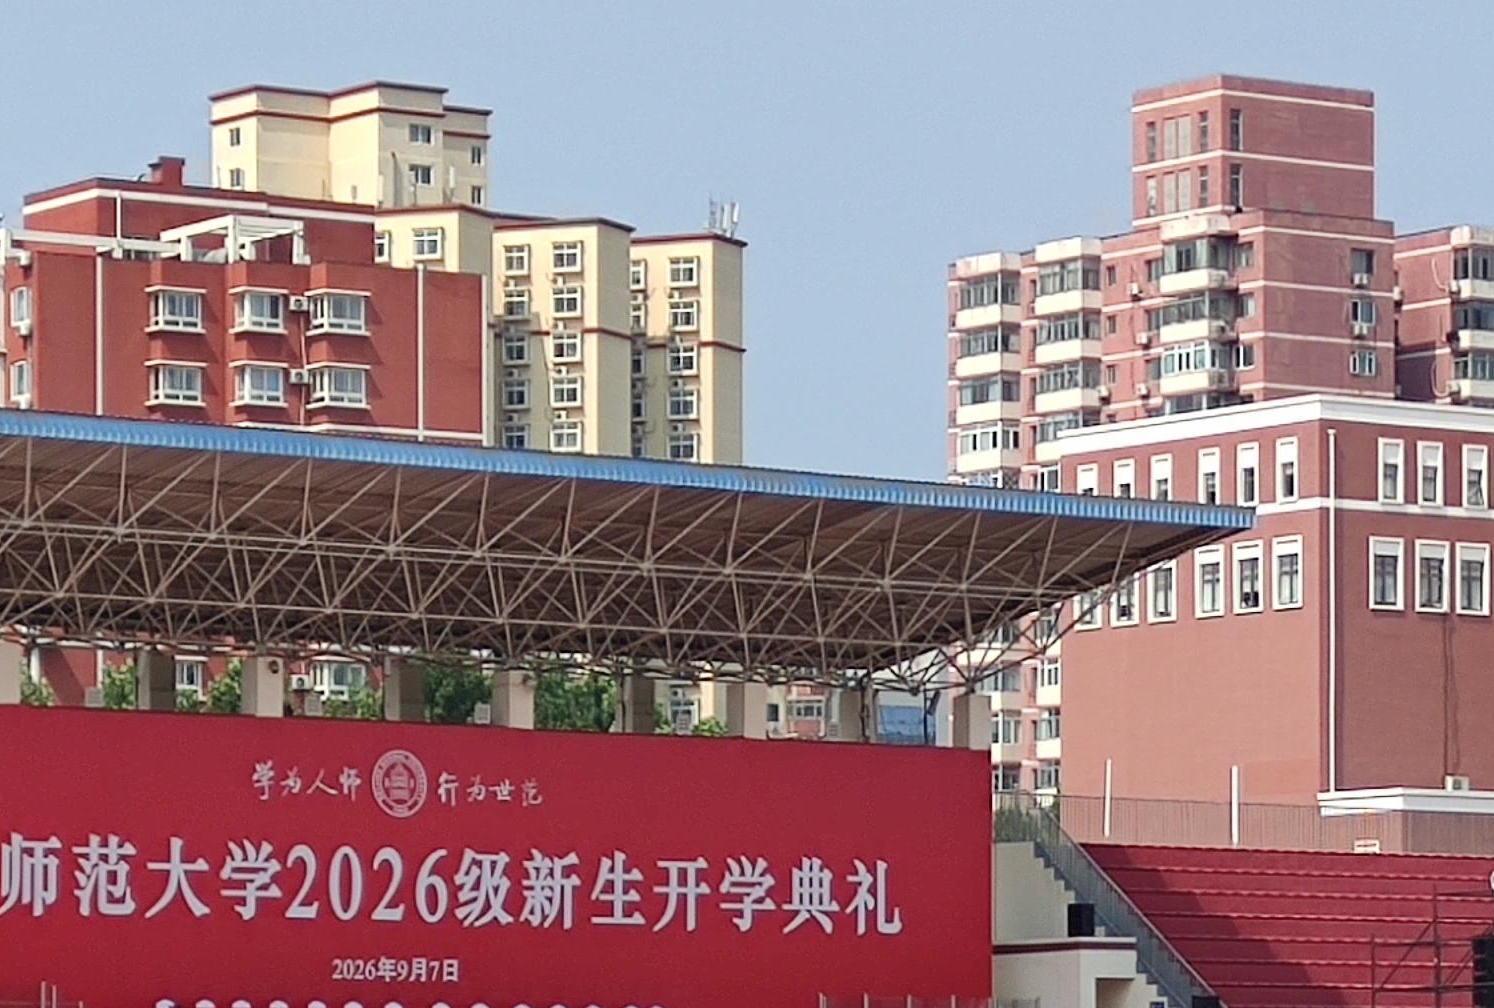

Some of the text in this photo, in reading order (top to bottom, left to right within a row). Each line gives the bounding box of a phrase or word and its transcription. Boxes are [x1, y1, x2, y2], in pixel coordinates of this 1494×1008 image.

[251, 760, 362, 801] 学为人师
[437, 771, 543, 807] 行为世范
[331, 956, 459, 983] 2026年9月7日
